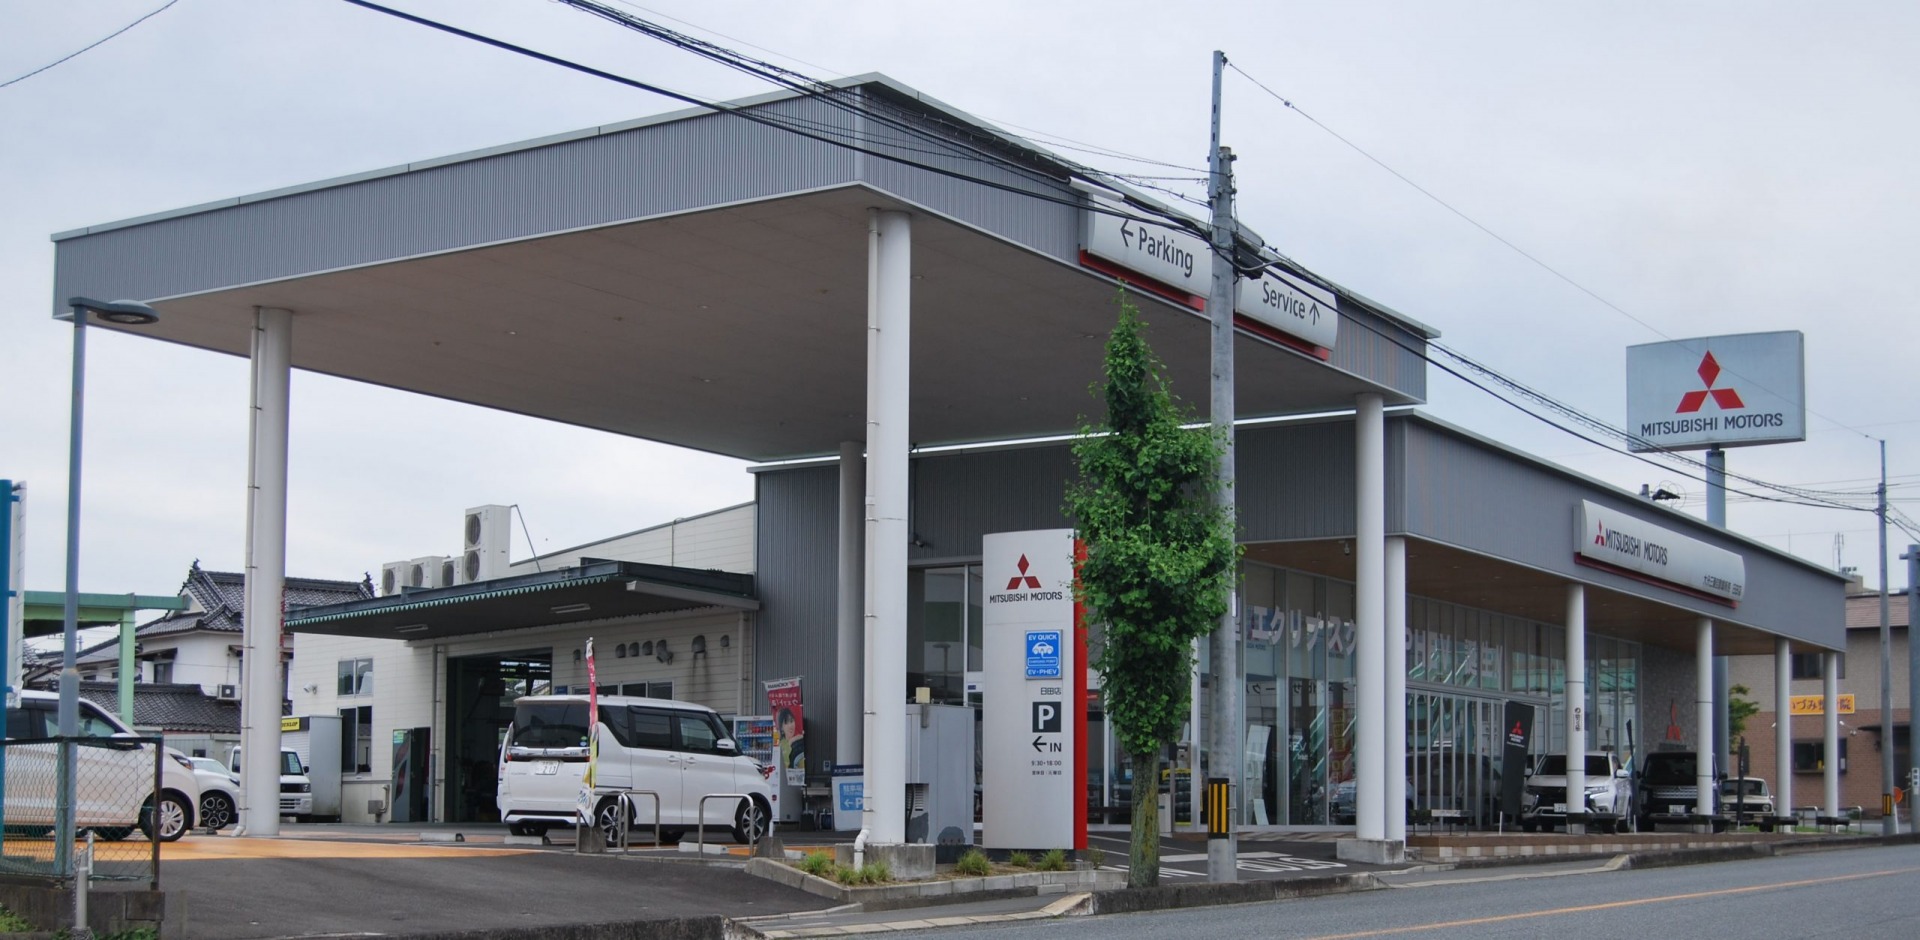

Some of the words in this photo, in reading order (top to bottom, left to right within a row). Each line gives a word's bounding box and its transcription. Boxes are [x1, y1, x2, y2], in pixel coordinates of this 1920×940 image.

[1139, 226, 1193, 278] Parking
[1263, 281, 1306, 319] Service
[1641, 417, 1718, 437] MITSUBISHI
[1724, 413, 1783, 429] MOTORS
[1605, 527, 1641, 557] MITSUBISHI
[1644, 541, 1668, 566] MOTORS
[990, 593, 1028, 603] MITSUBISHI
[1031, 592, 1063, 601] MOTORS
[1041, 687, 1062, 696] 日田店
[1038, 704, 1055, 730] P
[1049, 742, 1062, 753] IN
